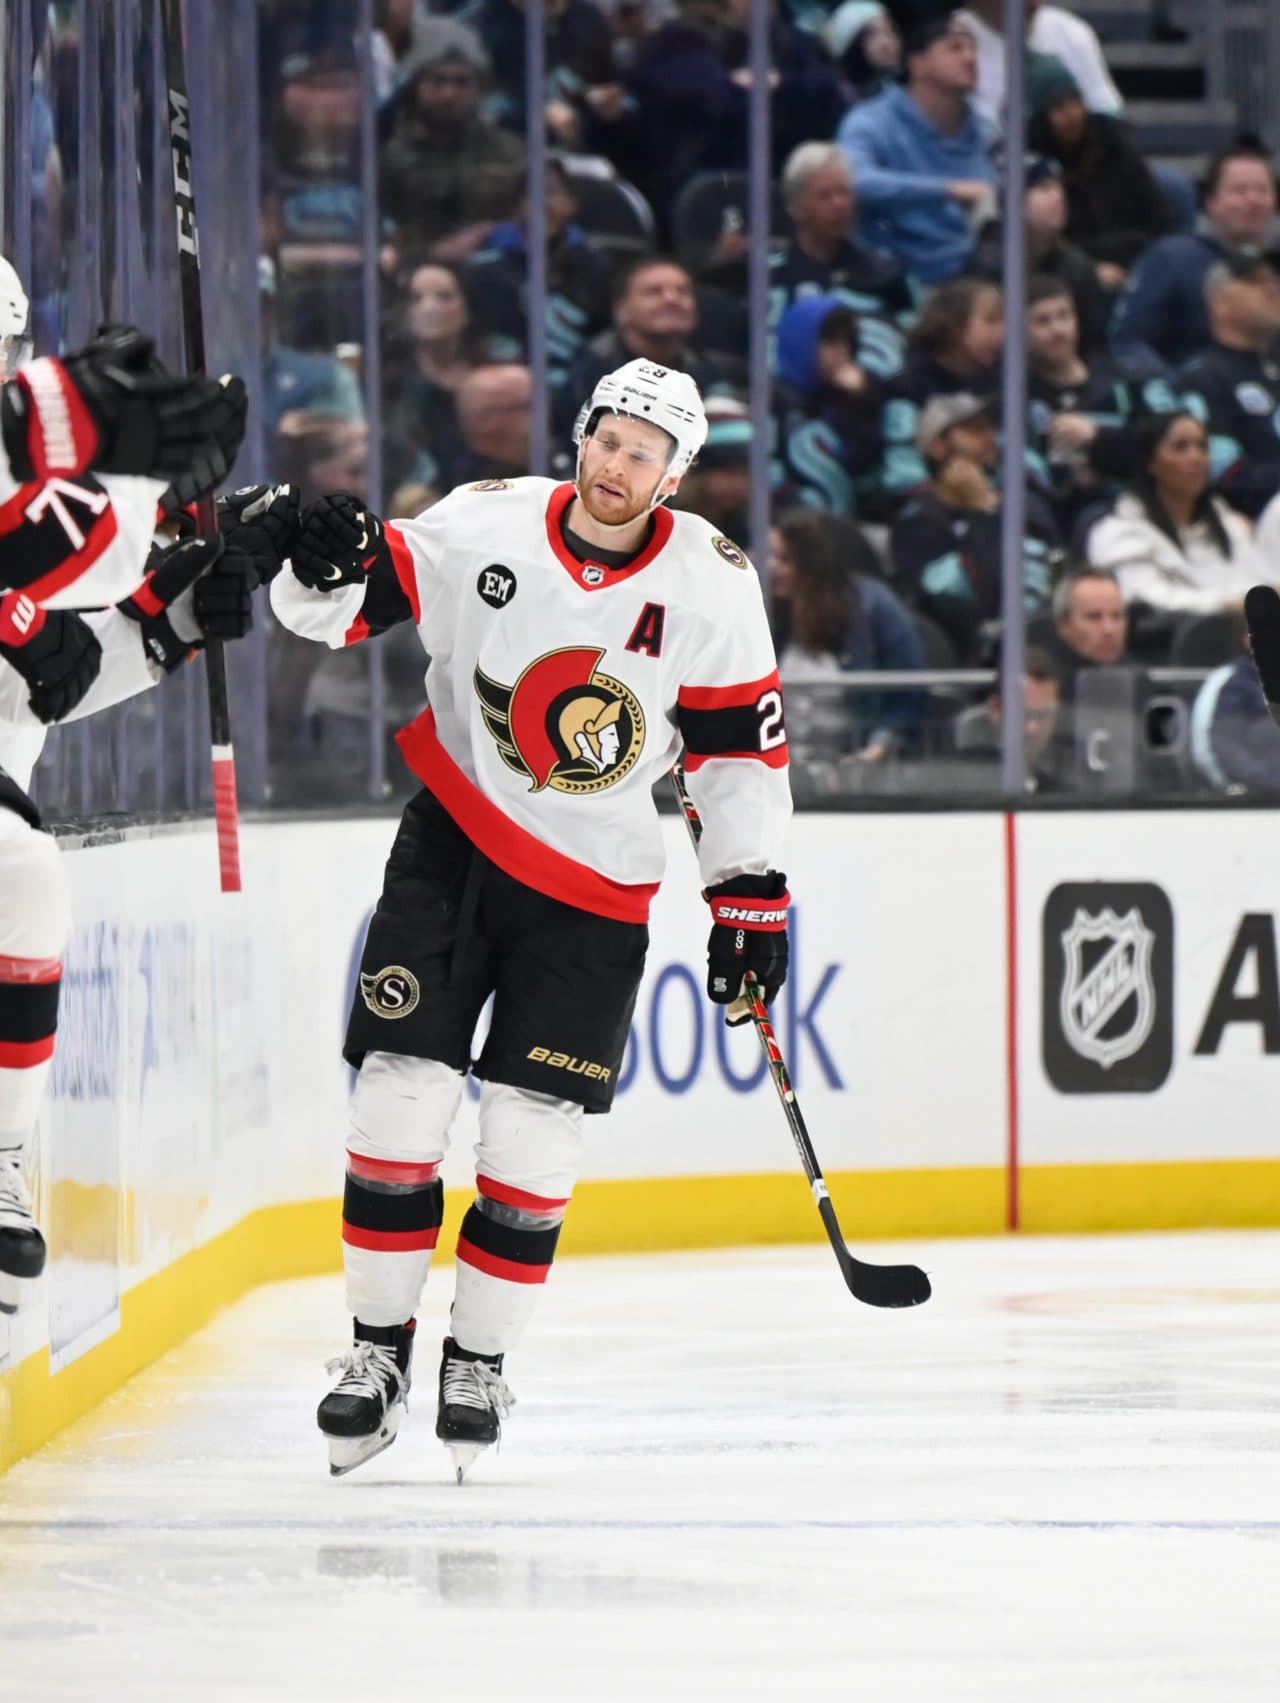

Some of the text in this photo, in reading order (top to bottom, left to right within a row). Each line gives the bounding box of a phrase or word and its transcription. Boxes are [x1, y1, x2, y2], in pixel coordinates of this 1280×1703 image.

[24, 476, 109, 551] 71
[483, 572, 513, 602] EM
[624, 601, 666, 658] A
[527, 1046, 612, 1084] BAUER
